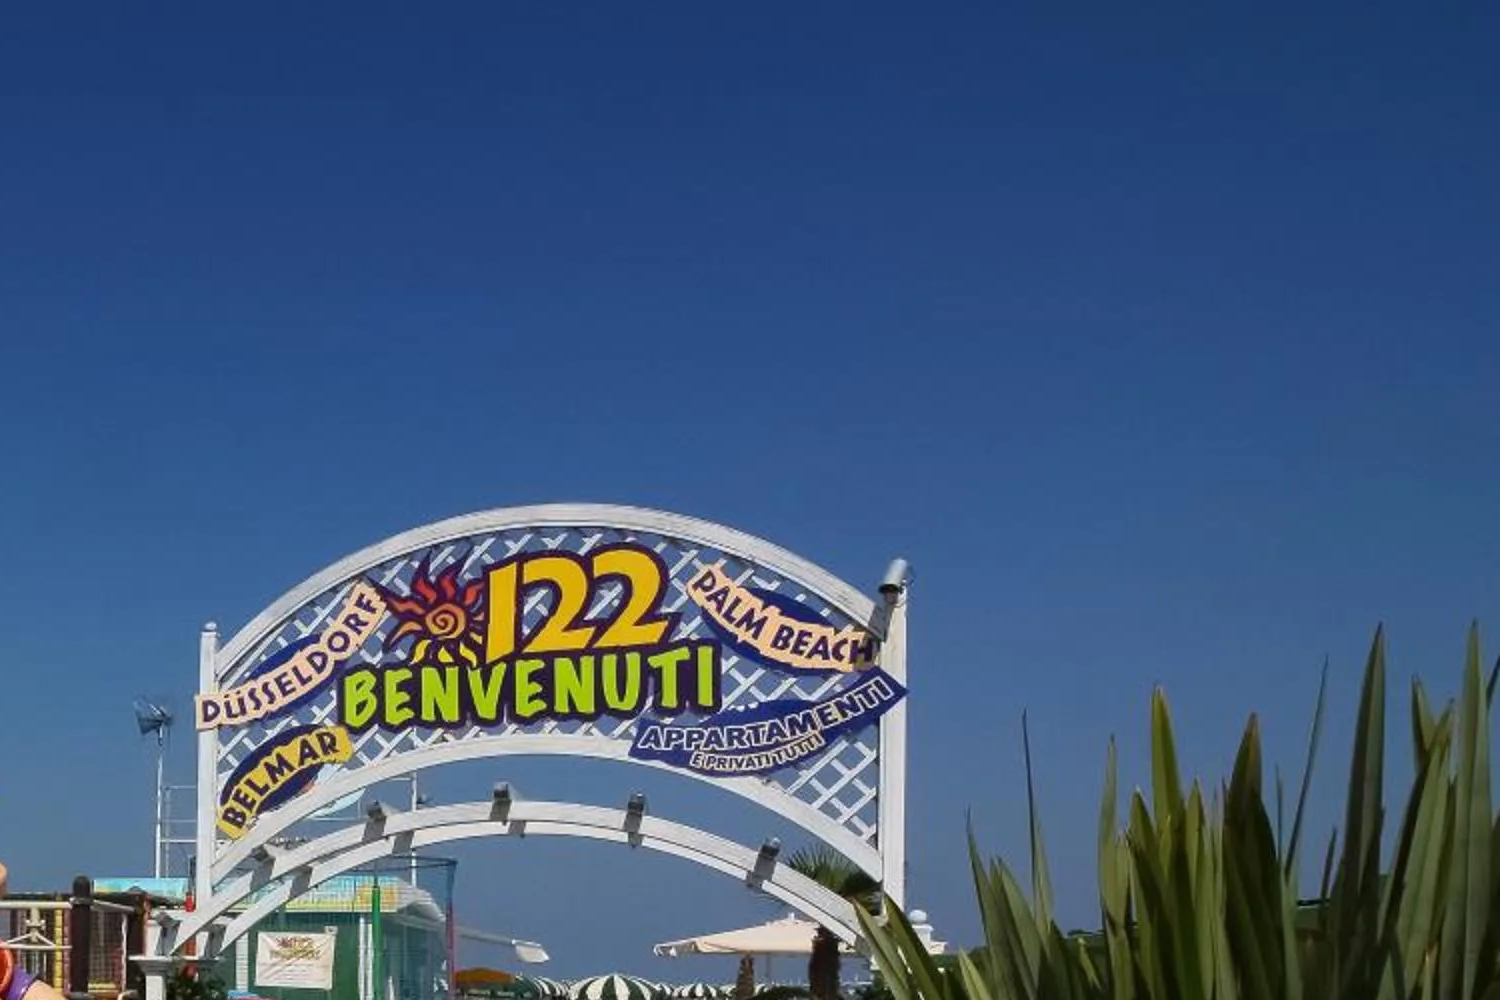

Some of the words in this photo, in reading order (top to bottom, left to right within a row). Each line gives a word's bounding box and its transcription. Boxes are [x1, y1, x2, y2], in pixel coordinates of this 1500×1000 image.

[485, 548, 670, 662] 122
[690, 569, 770, 641] PALM
[770, 622, 874, 665] BEACH
[201, 591, 380, 723] DÜSSELDORF
[343, 645, 715, 728] BENVENUTI
[638, 676, 894, 750] APPARTAMENTI
[221, 730, 341, 829] BELMAR
